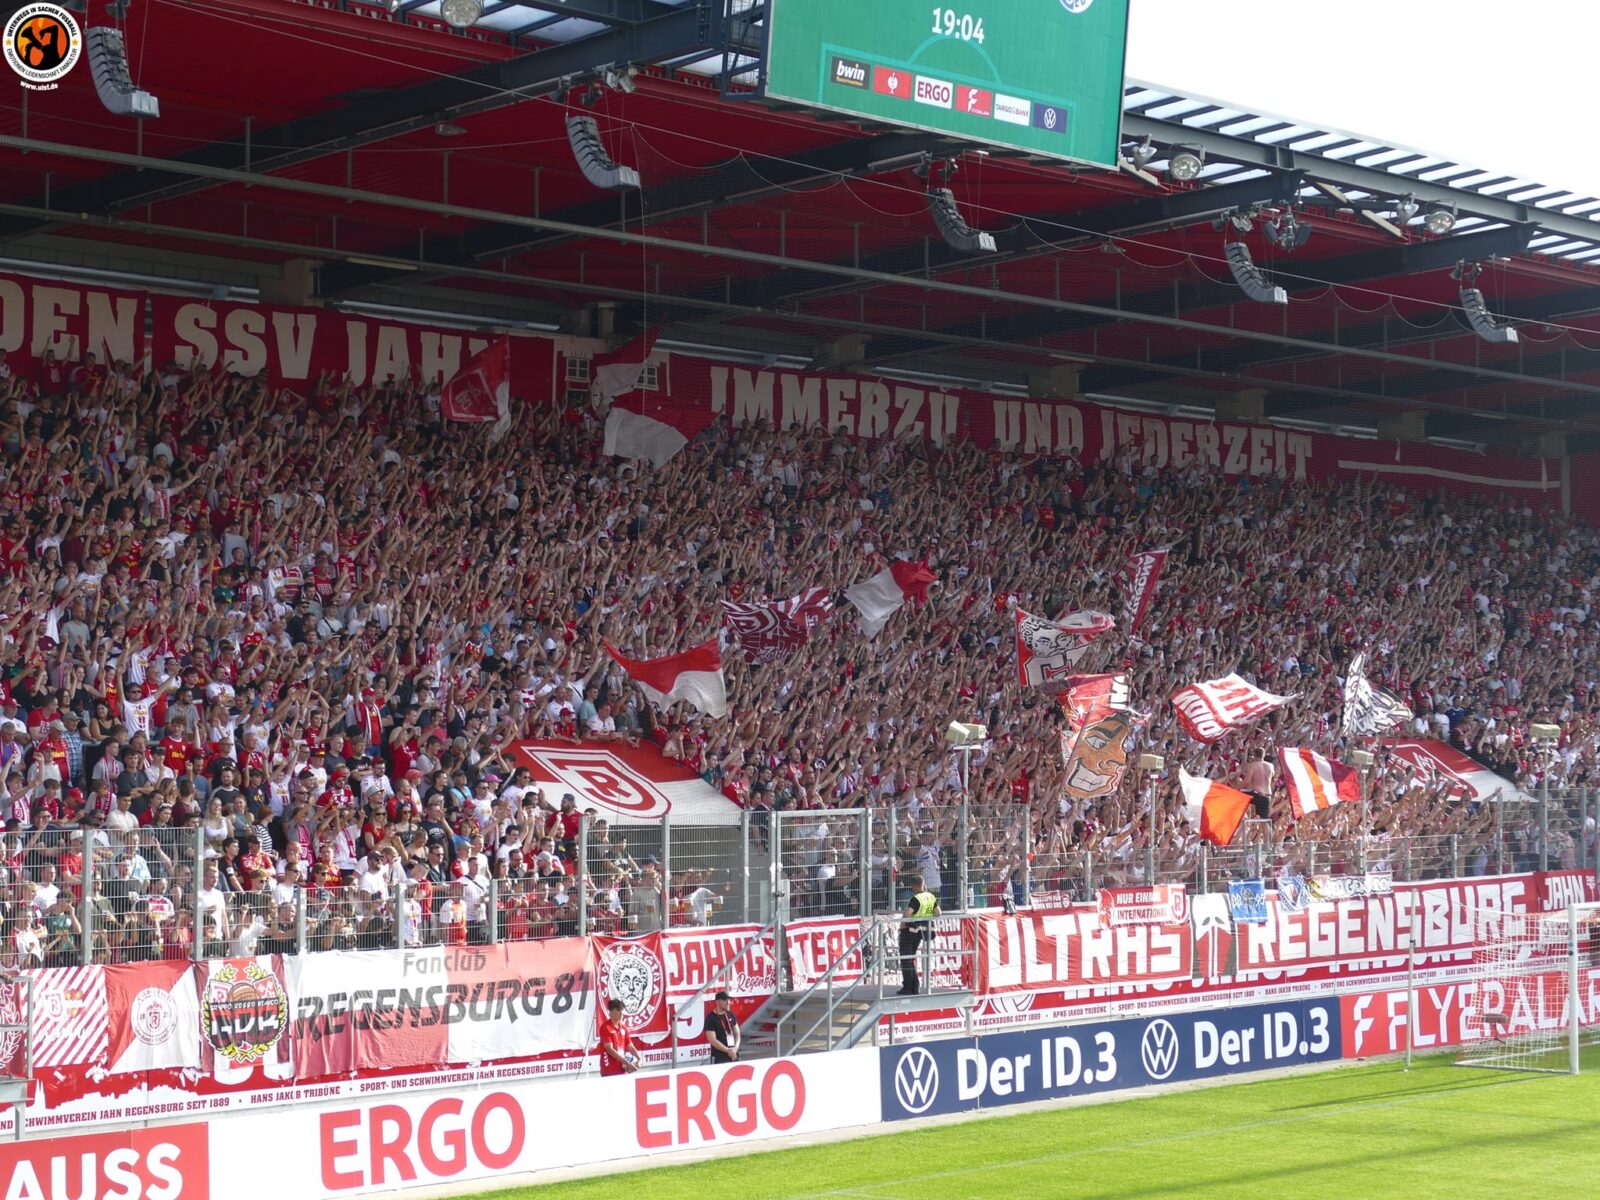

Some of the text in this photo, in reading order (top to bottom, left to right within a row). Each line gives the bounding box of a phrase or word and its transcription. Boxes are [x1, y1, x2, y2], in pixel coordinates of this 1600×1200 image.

[932, 7, 985, 44] 19:04
[836, 60, 865, 81] bwin
[917, 81, 951, 103] ERGO
[173, 303, 317, 379] SSV
[341, 319, 501, 388] JAH
[709, 366, 1313, 481] IMMERZU UND JEDERZEIT
[1116, 892, 1134, 904] NUR
[1543, 875, 1586, 911] JAHN
[1250, 880, 1527, 964] REGENSBURG
[403, 951, 486, 978] Fanclub
[985, 912, 1181, 988] ULTRAS
[296, 971, 592, 1042] REGENSBURG 81
[879, 1026, 901, 1036] SPOT-
[901, 1025, 914, 1034] UND
[914, 1021, 962, 1033] SCHWIMMVEREIN
[1194, 1020, 1255, 1070] Der
[1263, 1006, 1330, 1061] ID.3
[360, 1080, 389, 1092] SPORT-
[391, 1079, 407, 1089] UND
[409, 1071, 474, 1088] SCHWIMMVEREIN
[497, 1064, 545, 1078] REGENSBURG
[547, 1062, 563, 1073] SEIT
[565, 1060, 582, 1071] 1889
[958, 1044, 1030, 1101] Der
[1041, 1030, 1118, 1087] ID.3
[99, 1107, 122, 1120] JAHN
[125, 1101, 184, 1117] REGENSBURG
[186, 1099, 207, 1111] SEIT
[209, 1097, 230, 1108] 1889
[250, 1093, 273, 1104] HANS
[304, 1084, 341, 1099] TRIBÜNE
[635, 1059, 806, 1148] ERGO
[318, 1091, 526, 1190] ERGO
